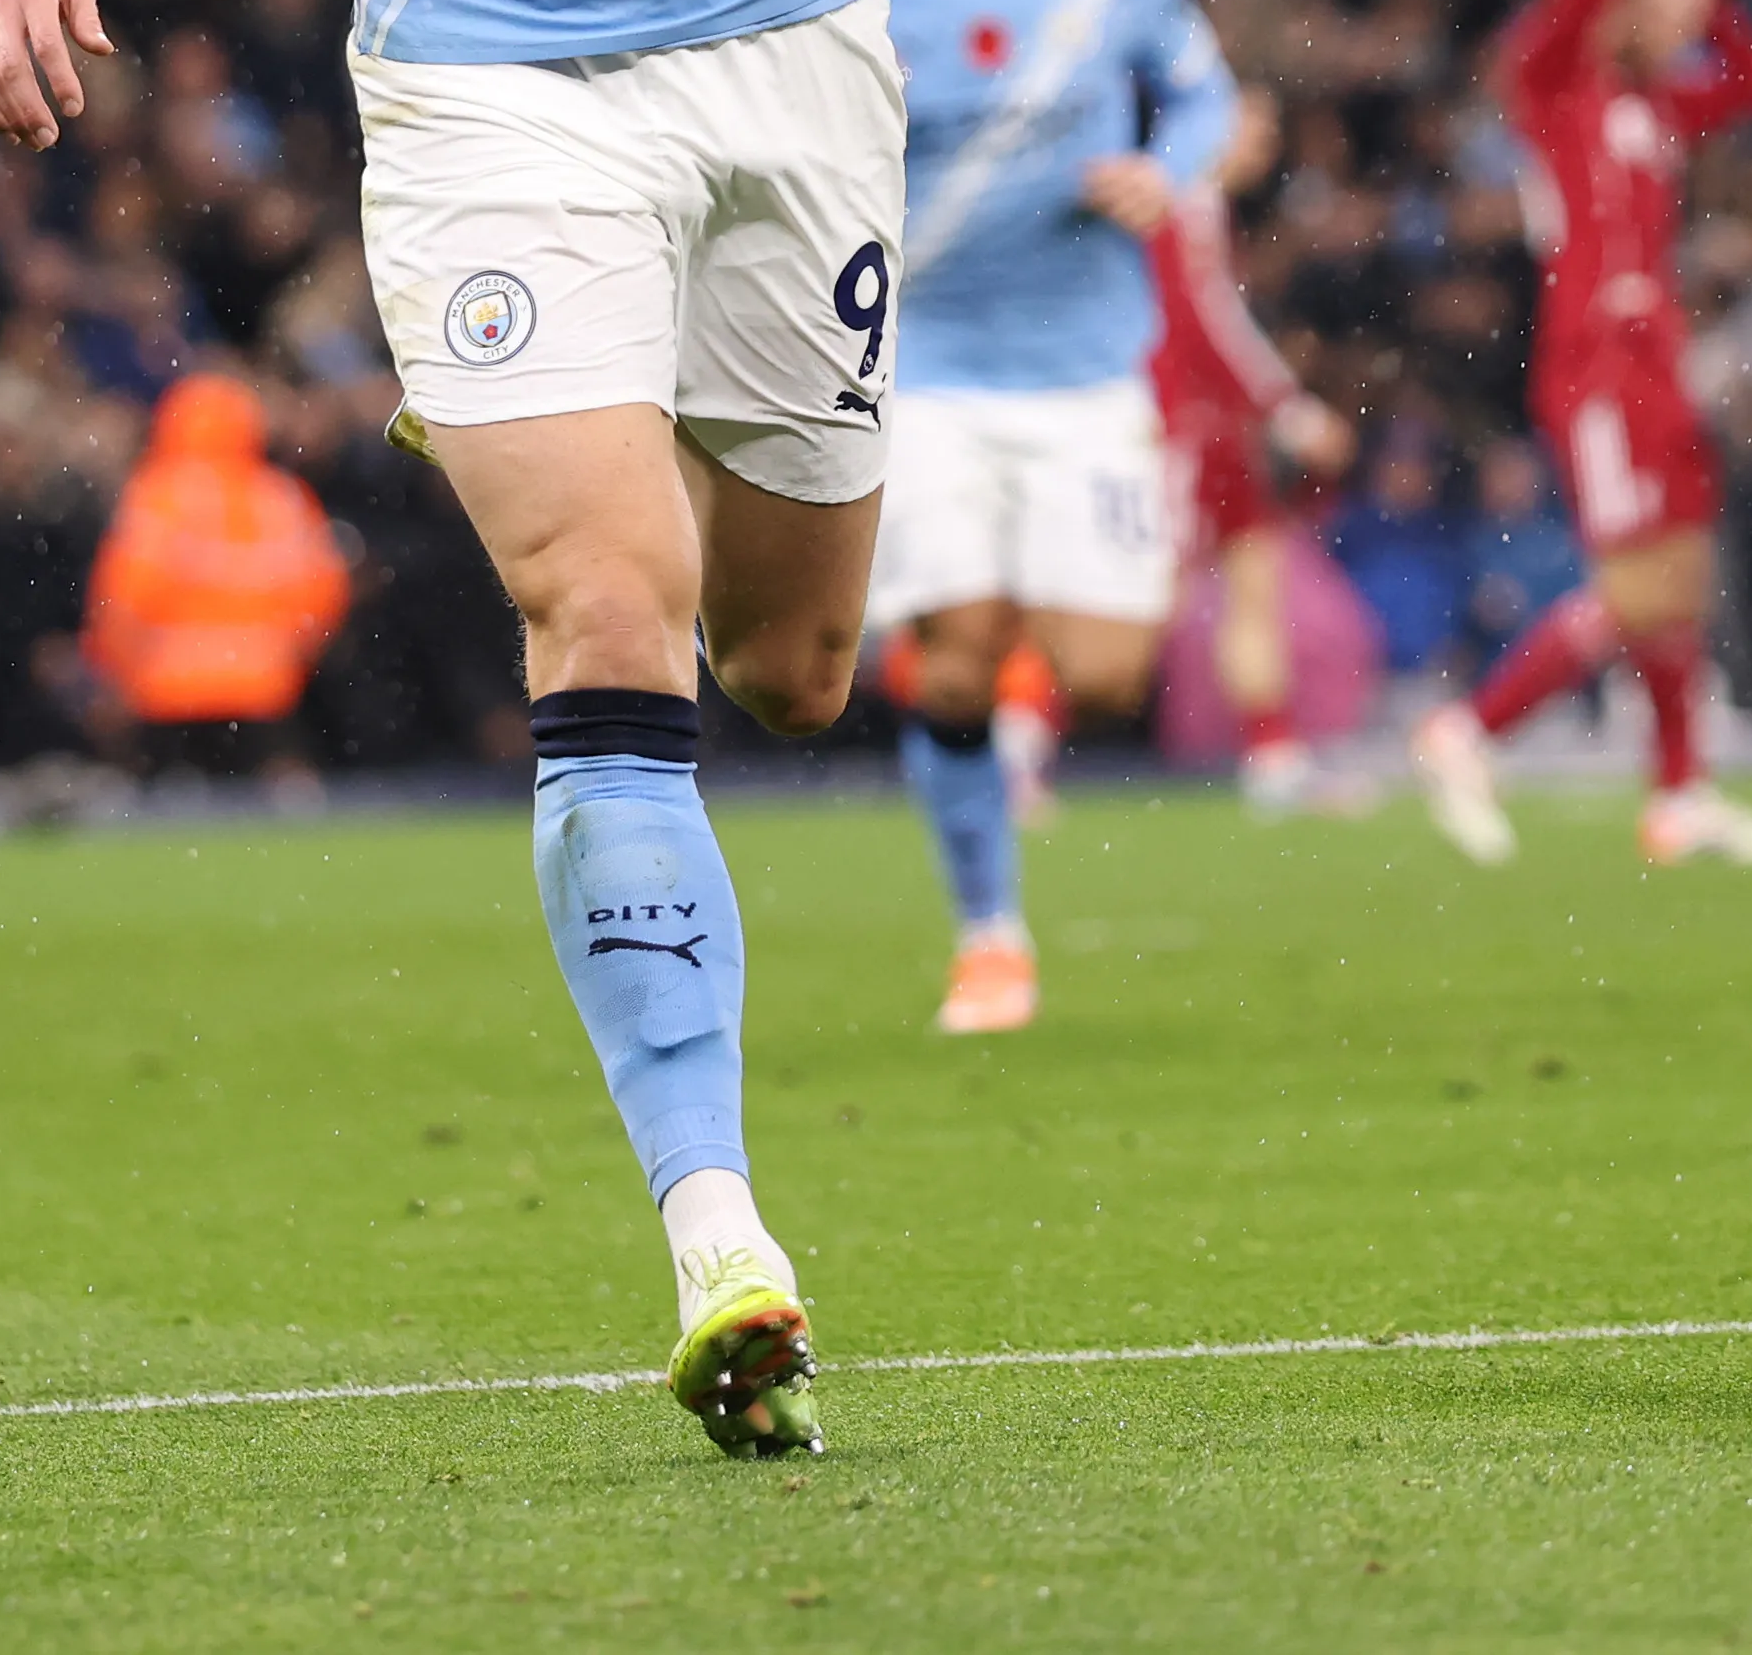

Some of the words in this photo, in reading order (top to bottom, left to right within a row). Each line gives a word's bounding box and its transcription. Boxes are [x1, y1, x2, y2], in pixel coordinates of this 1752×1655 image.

[452, 278, 521, 318] MANCHESTER
[834, 240, 889, 380] 9
[483, 345, 508, 359] CITY
